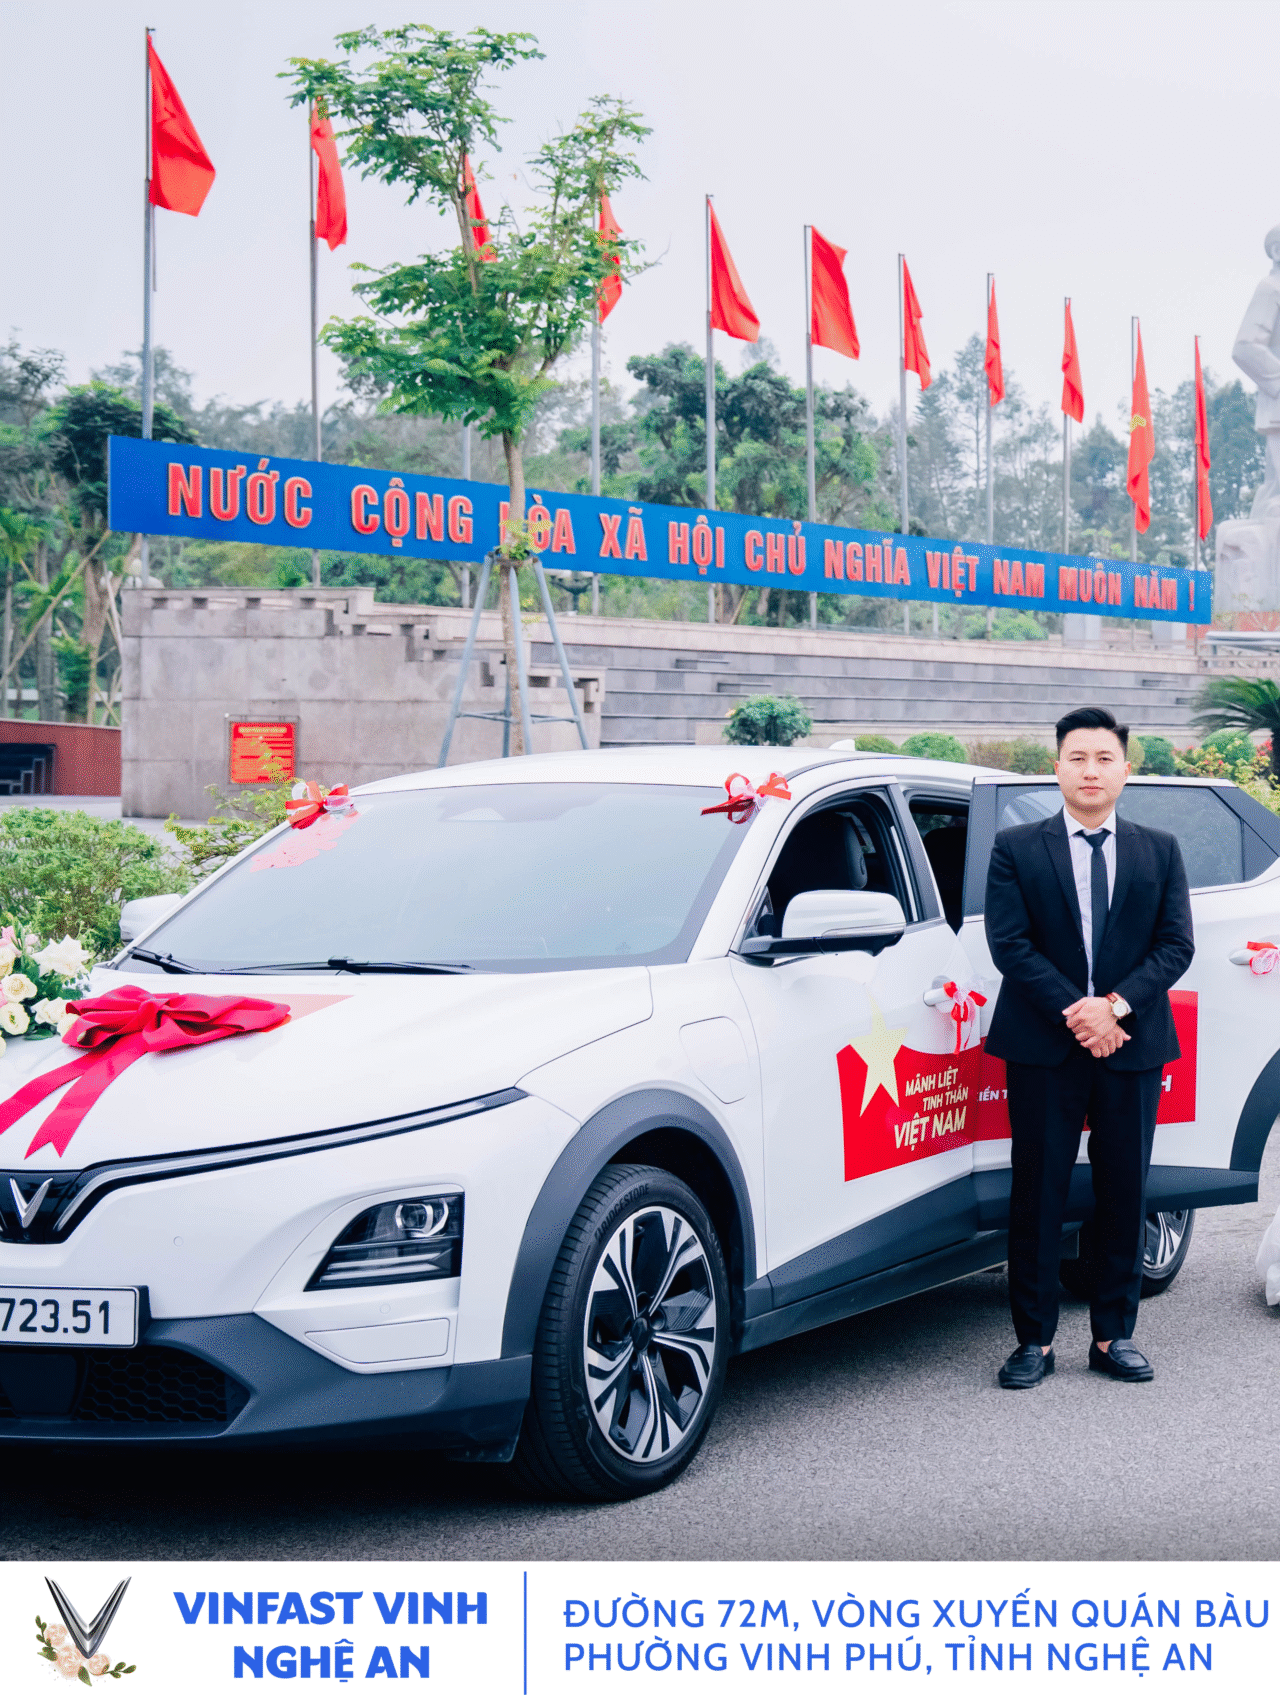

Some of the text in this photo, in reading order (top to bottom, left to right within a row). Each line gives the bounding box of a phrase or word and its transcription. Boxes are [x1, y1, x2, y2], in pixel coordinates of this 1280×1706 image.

[168, 458, 312, 528] NƯỚC
[351, 477, 473, 547] CỘNG
[599, 506, 648, 561] XÃ
[668, 515, 725, 575] HỘI
[745, 521, 806, 575] CHỦ
[824, 538, 910, 585] NGHĨA
[926, 546, 979, 597] VIỆT
[993, 559, 1045, 598] NAM
[1059, 563, 1122, 606] MUÔN
[1134, 570, 1177, 611] NĂM
[937, 1065, 959, 1090] LIỆT
[922, 1093, 943, 1112] TINH
[894, 1105, 967, 1151] VIỆT NAM
[0, 1298, 110, 1334] 723.51
